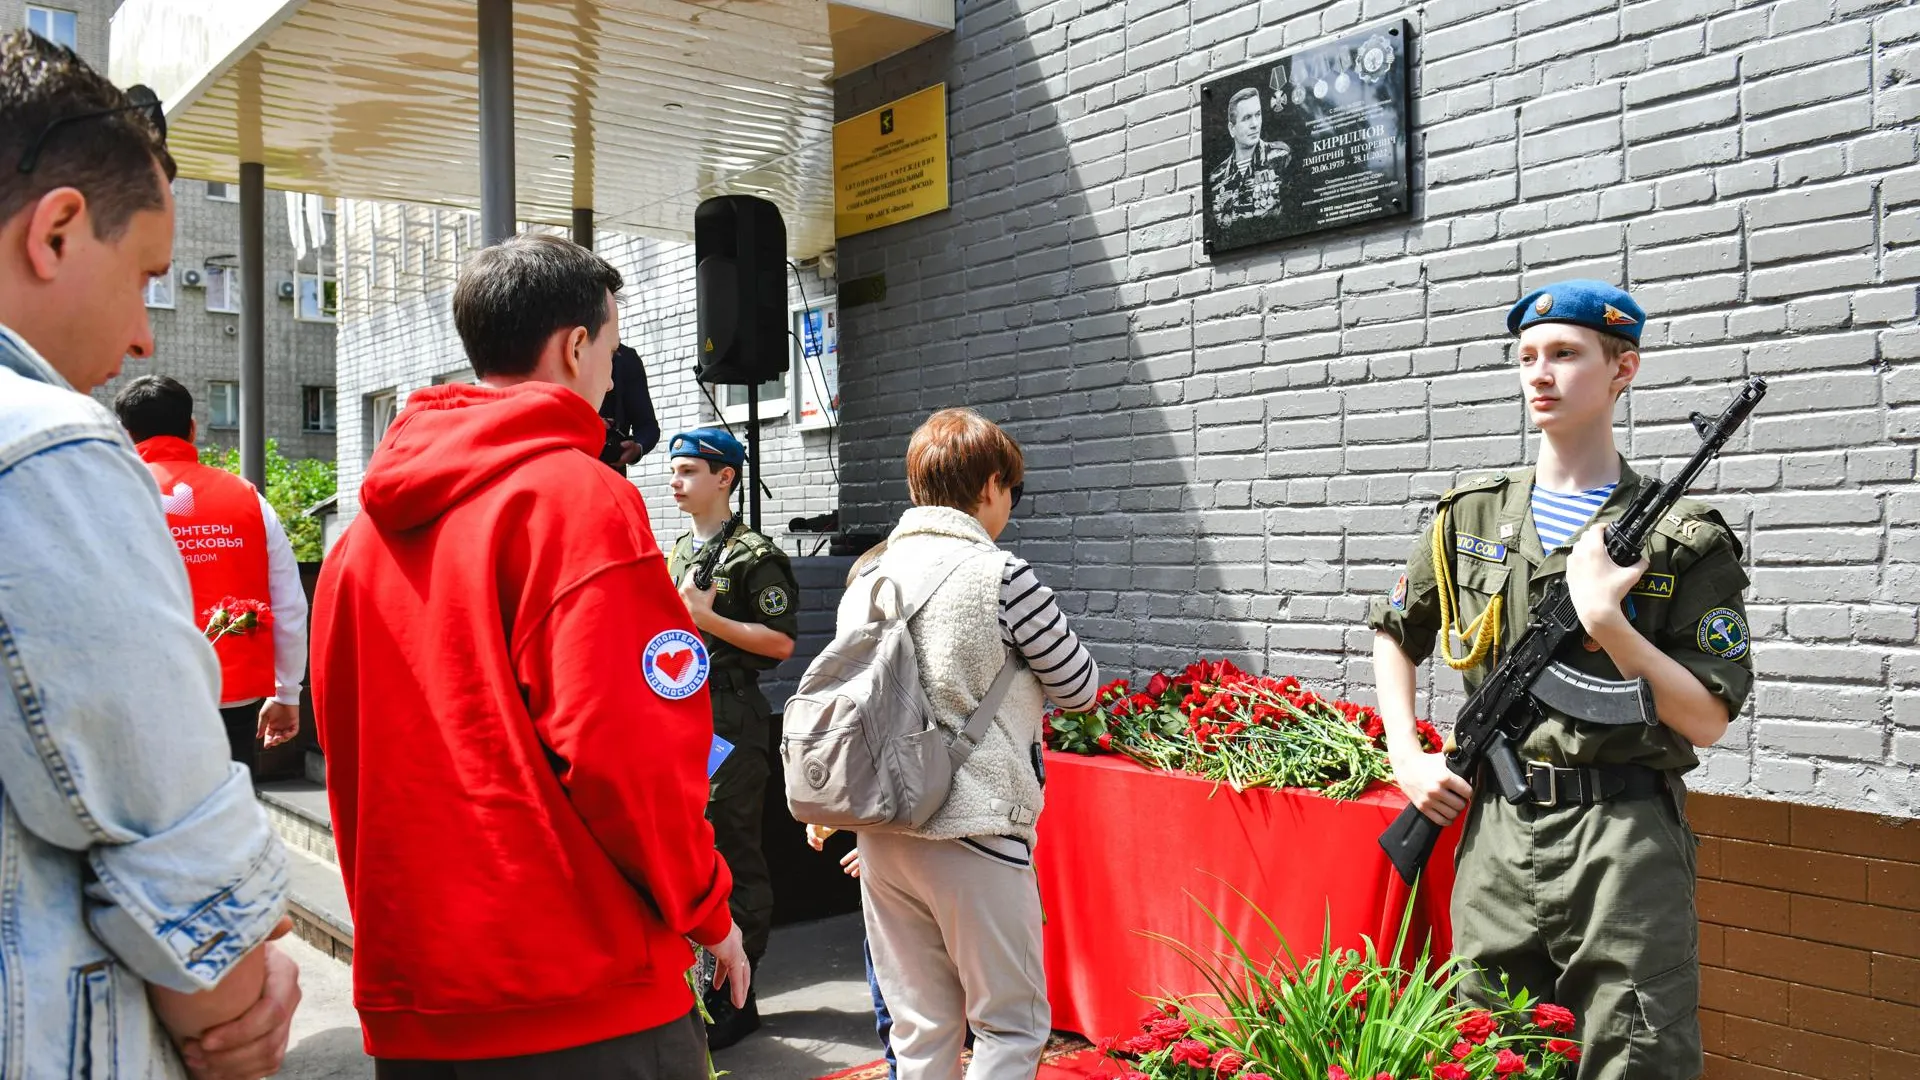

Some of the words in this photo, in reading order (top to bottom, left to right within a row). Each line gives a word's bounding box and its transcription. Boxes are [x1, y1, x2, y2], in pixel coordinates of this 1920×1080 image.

[1312, 124, 1385, 153] КИРИЛЛОВ
[1302, 149, 1344, 168] ДМИТРИЙ
[1350, 135, 1396, 155] ИГОРЕВИЧ
[1311, 159, 1345, 175] 20.06.1979
[170, 524, 233, 537] ОНТЕРЫ
[176, 538, 244, 550] ОСКОВЬЯ
[647, 632, 700, 657] ВОЛОНТЕРЫ
[1721, 641, 1747, 658] РОССИЯ
[647, 664, 707, 697] ПОДМОСКОВЬЯ
